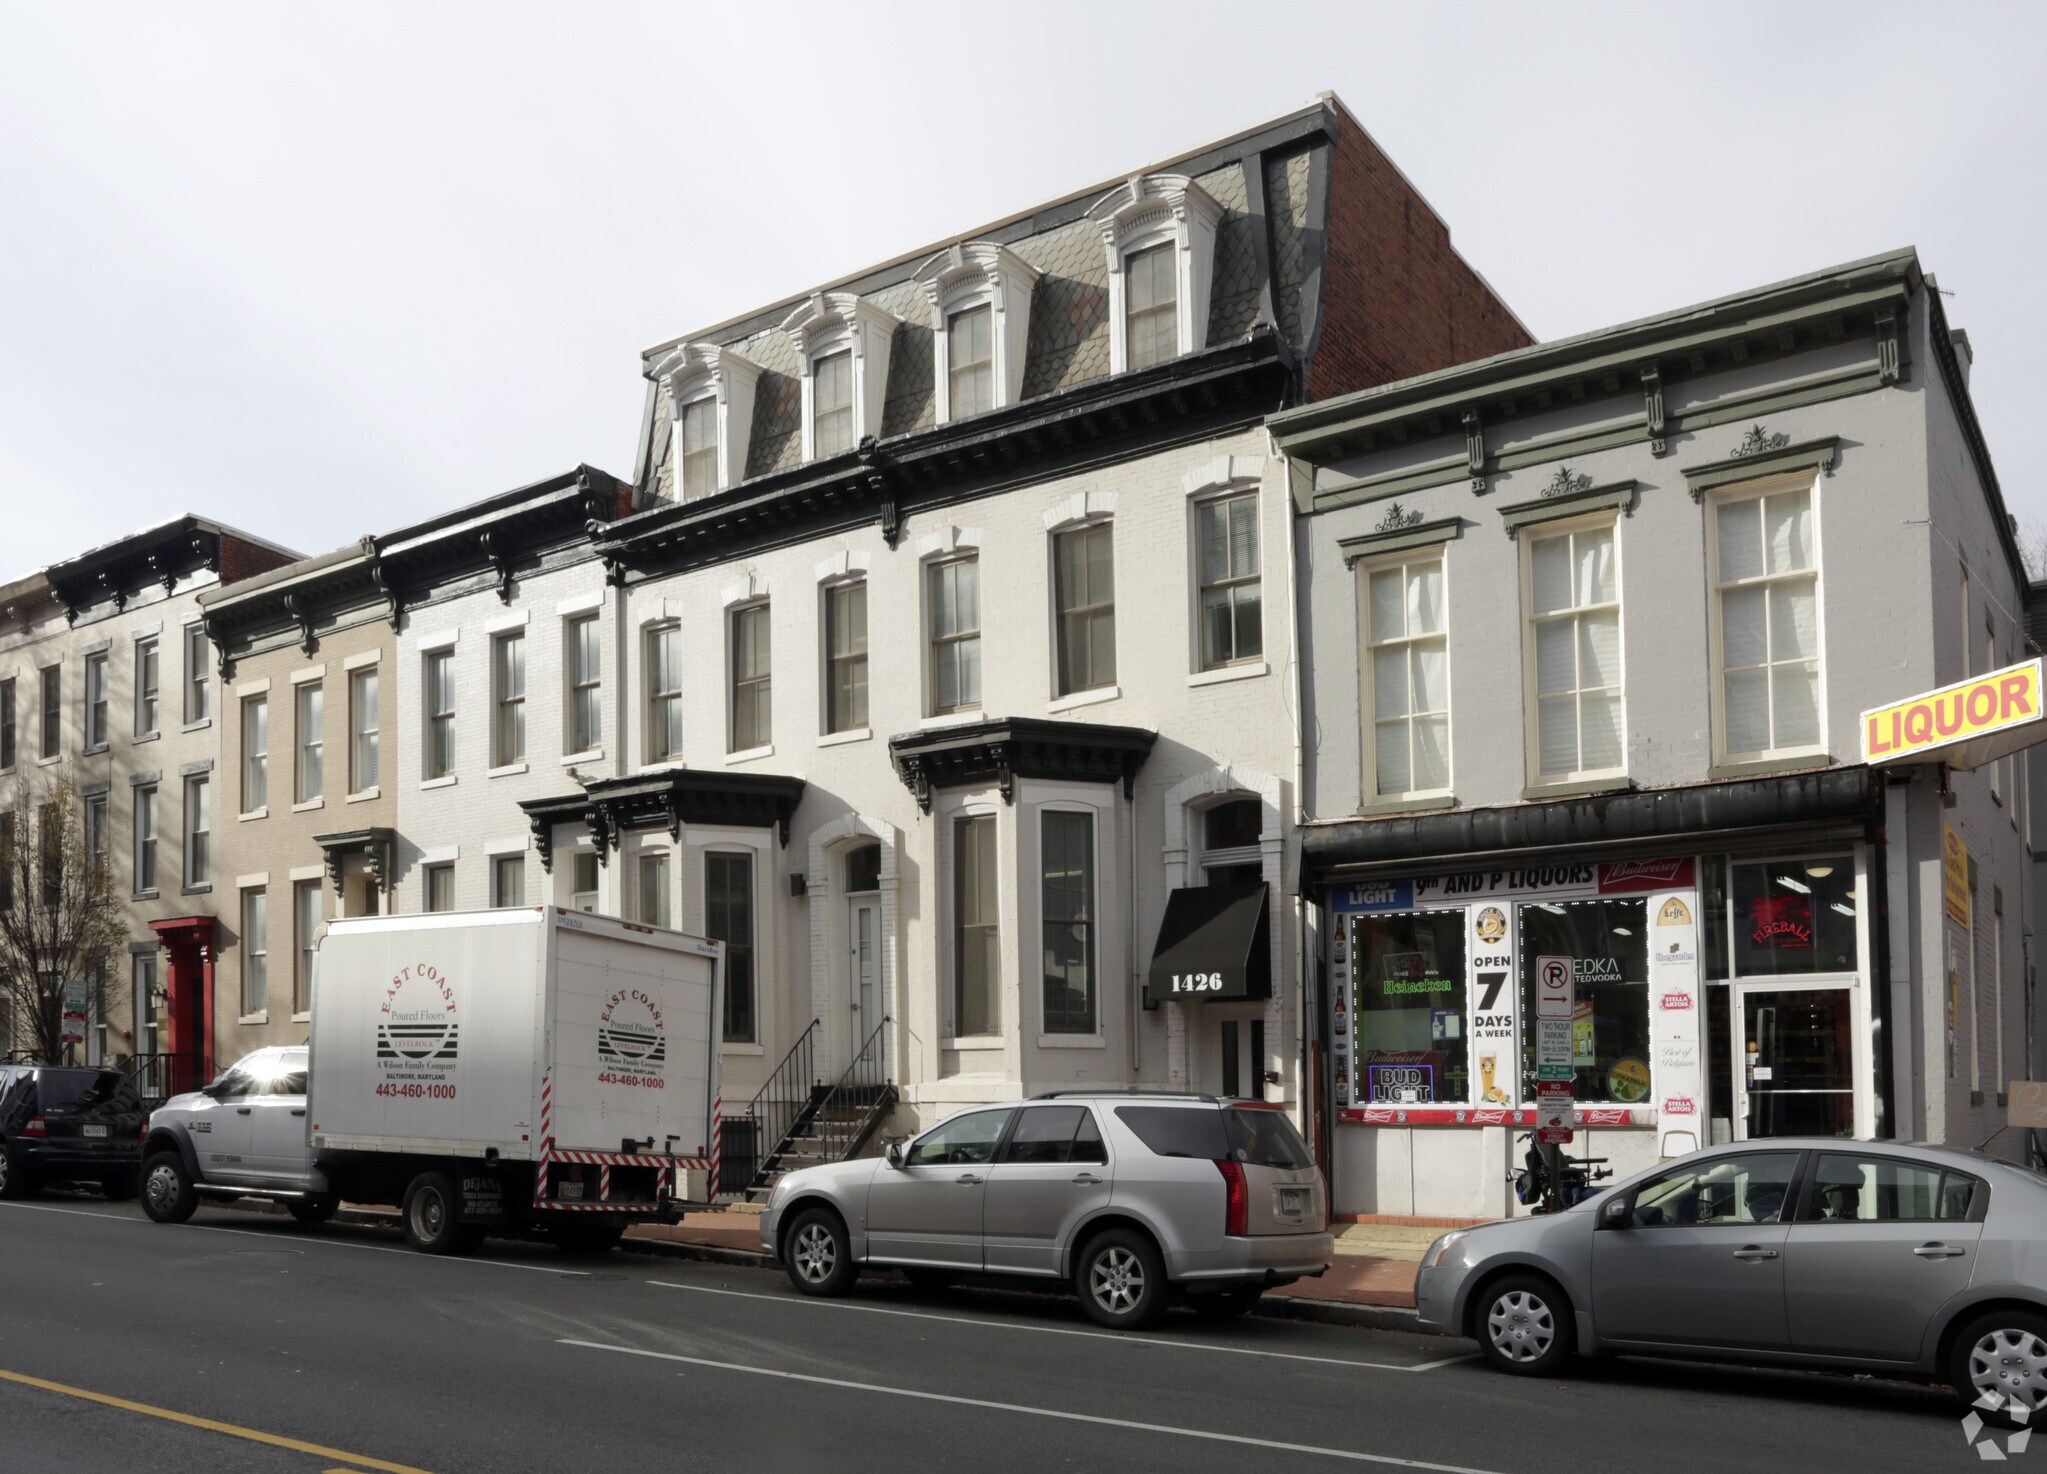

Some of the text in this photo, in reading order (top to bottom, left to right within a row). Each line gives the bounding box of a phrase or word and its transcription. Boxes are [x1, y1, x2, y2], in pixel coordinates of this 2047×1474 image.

[1868, 674, 2032, 755] LIQUOR
[1612, 861, 1679, 876] Budweiser
[1444, 874, 1483, 894] AND
[1489, 872, 1504, 890] P
[1508, 863, 1594, 889] LIQUORS
[1349, 889, 1397, 905] LIGHT
[1663, 907, 1684, 919] Leffe
[1752, 921, 1811, 943] FIREBALL
[1474, 956, 1511, 967] OPEN
[1171, 972, 1223, 993] 1426
[1591, 974, 1622, 982] VODKA
[381, 963, 457, 1014] EAST COAST
[1383, 978, 1452, 995] Heineken
[1477, 972, 1508, 1010] 7
[391, 1010, 446, 1021] Poured Floors
[601, 990, 663, 1030] EAST COAST
[610, 1020, 655, 1034] Poured Floors
[1474, 1015, 1512, 1027] DAYS
[1541, 1022, 1570, 1030] TWO HOUR
[1475, 1029, 1512, 1038] A WEEK
[1544, 1031, 1567, 1039] PARKING
[1367, 1050, 1423, 1063] Budweiser
[1661, 1046, 1694, 1058] Best of
[377, 1060, 457, 1072] A Wilson Family Company
[640, 1060, 664, 1071] Company
[1552, 1065, 1557, 1074] 2
[1661, 1057, 1696, 1069] Belgium
[386, 1073, 417, 1081] BALTIMORE,
[598, 1072, 665, 1089] 443-460-1000
[1380, 1068, 1422, 1086] BUD
[376, 1082, 456, 1099] 443-460-1000
[462, 1176, 502, 1192] DEJANA
